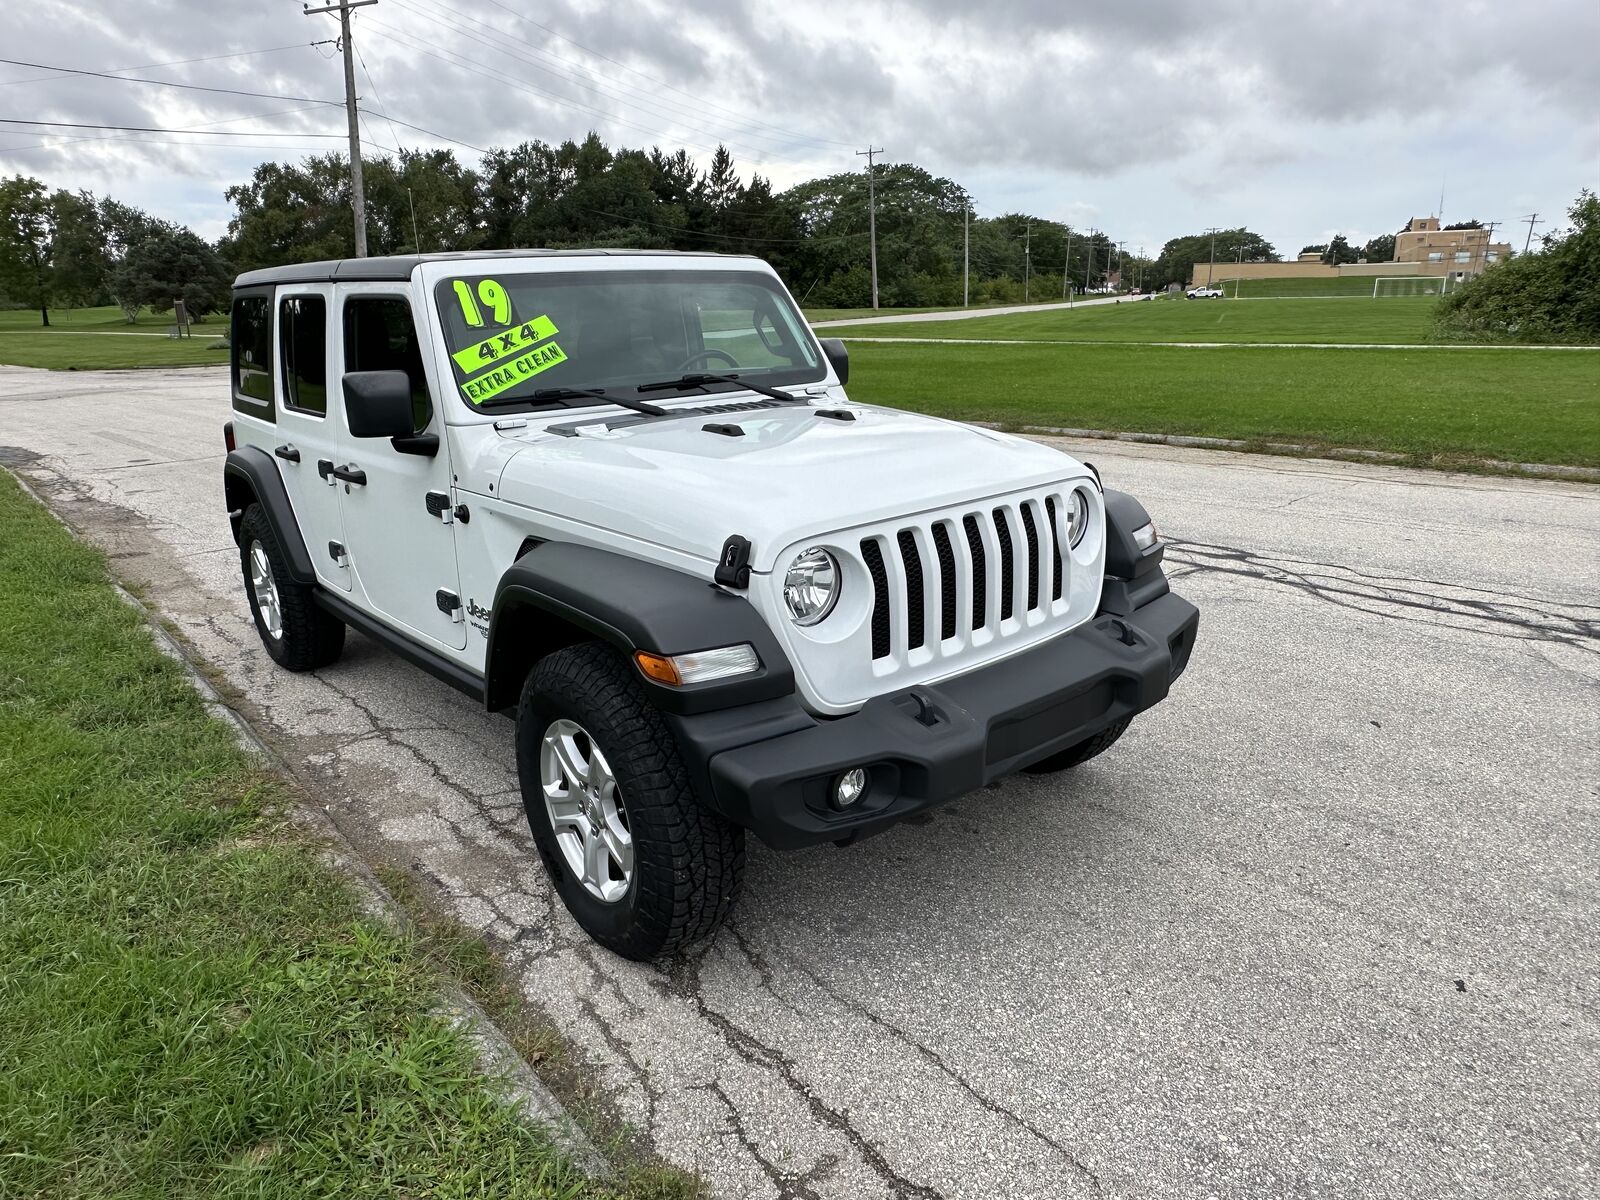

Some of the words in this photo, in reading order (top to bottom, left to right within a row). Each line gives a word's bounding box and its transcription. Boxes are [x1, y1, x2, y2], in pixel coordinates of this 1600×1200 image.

[453, 279, 512, 327] 19
[466, 368, 516, 399] EXTRA
[516, 345, 562, 375] CLEAN
